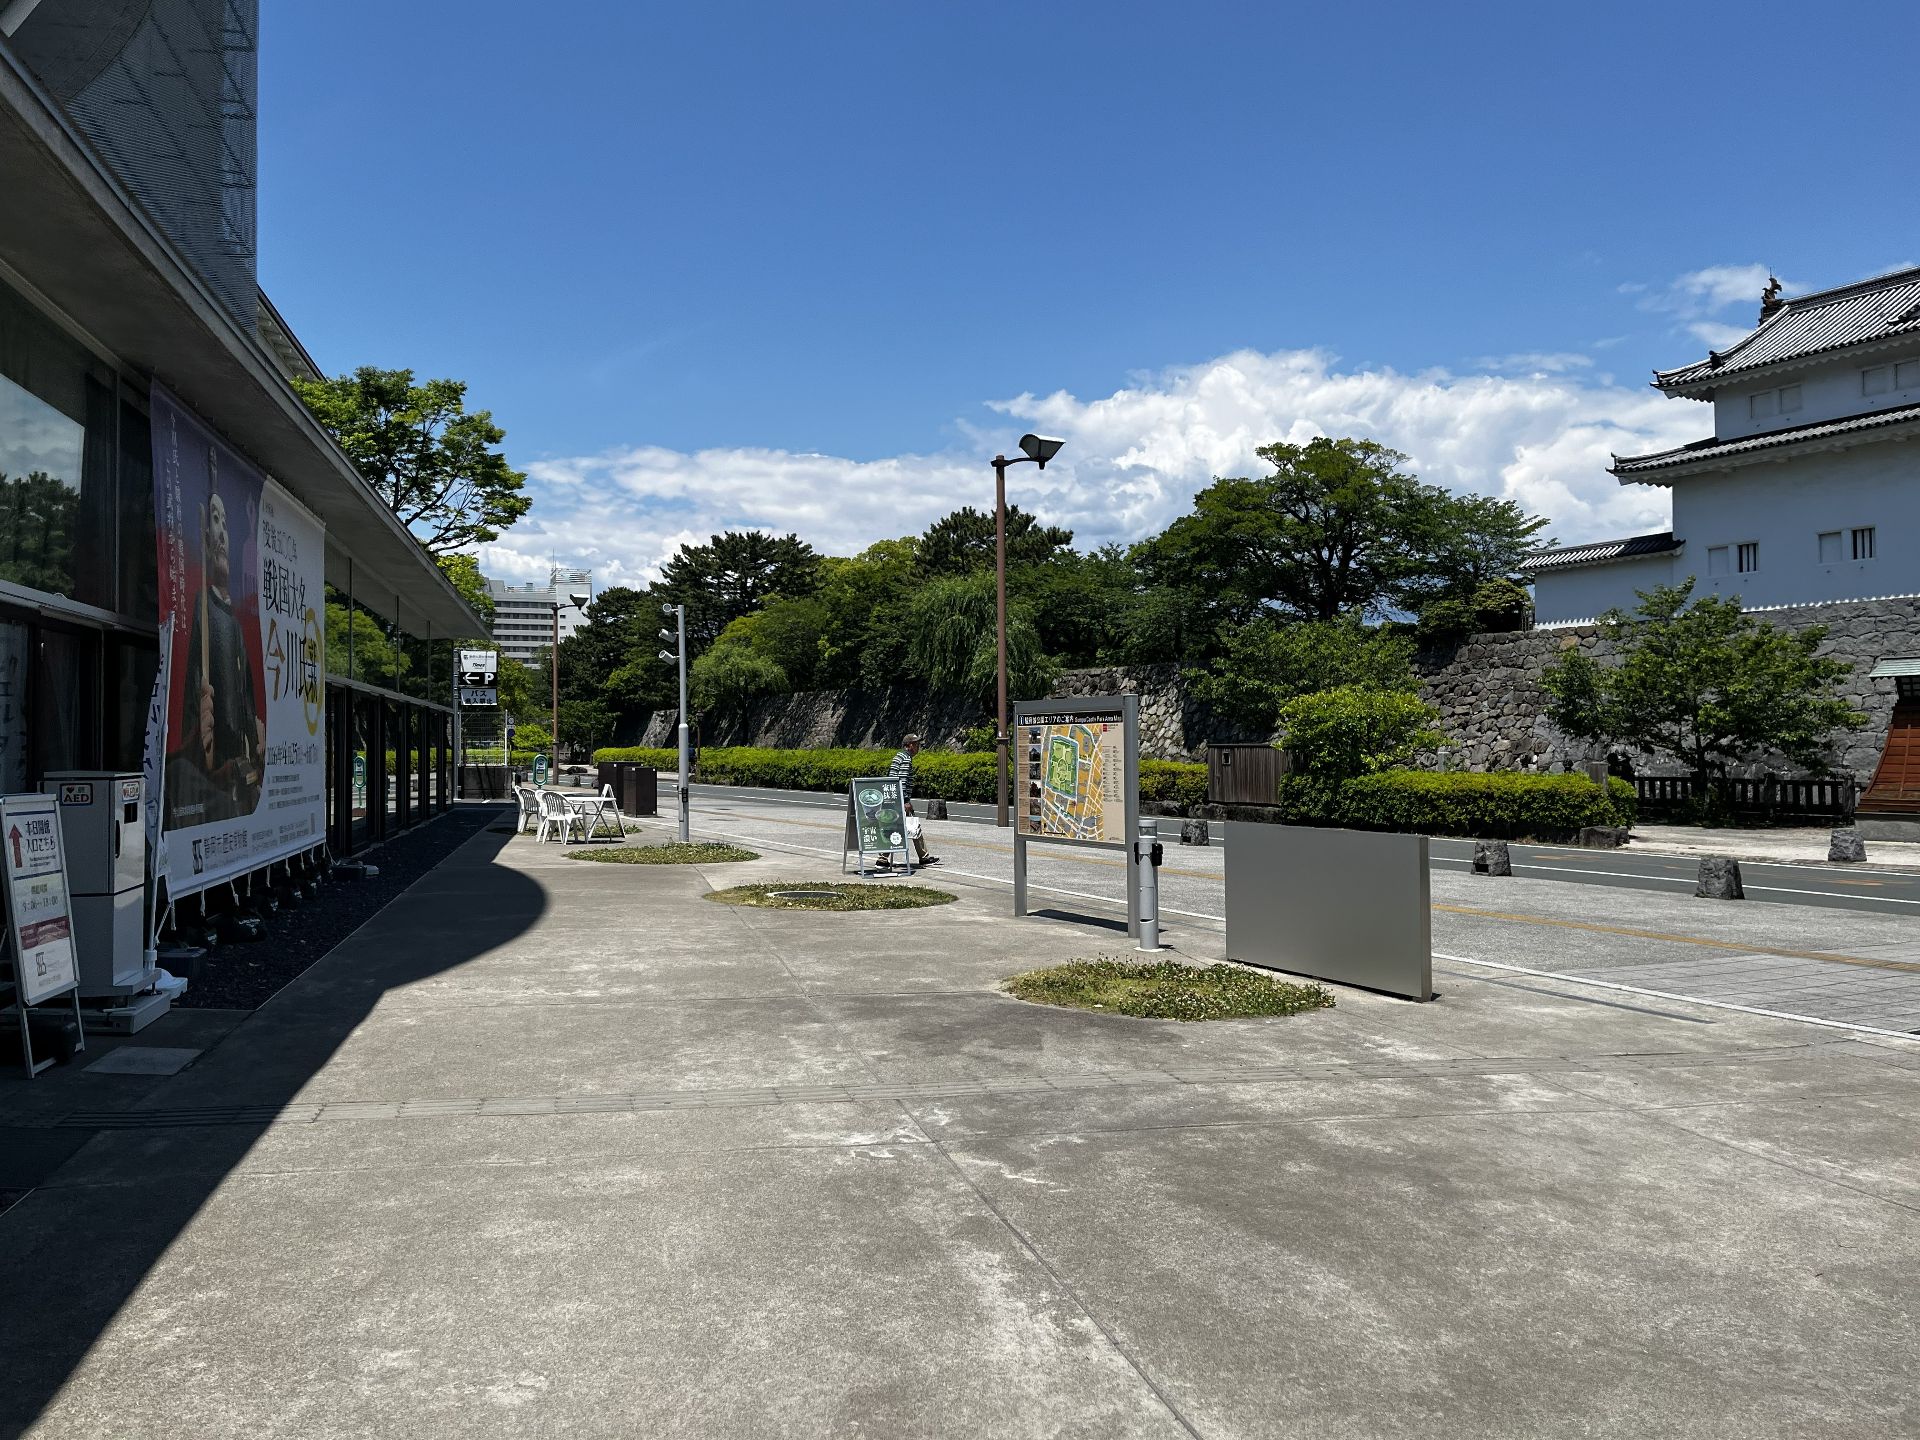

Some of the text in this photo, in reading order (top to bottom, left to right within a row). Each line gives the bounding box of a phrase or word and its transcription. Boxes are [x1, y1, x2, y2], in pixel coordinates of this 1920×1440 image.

[262, 558, 307, 622] 戦国大名
[484, 673, 495, 685] P
[63, 793, 90, 804] AED
[26, 836, 56, 854] 入口こちら
